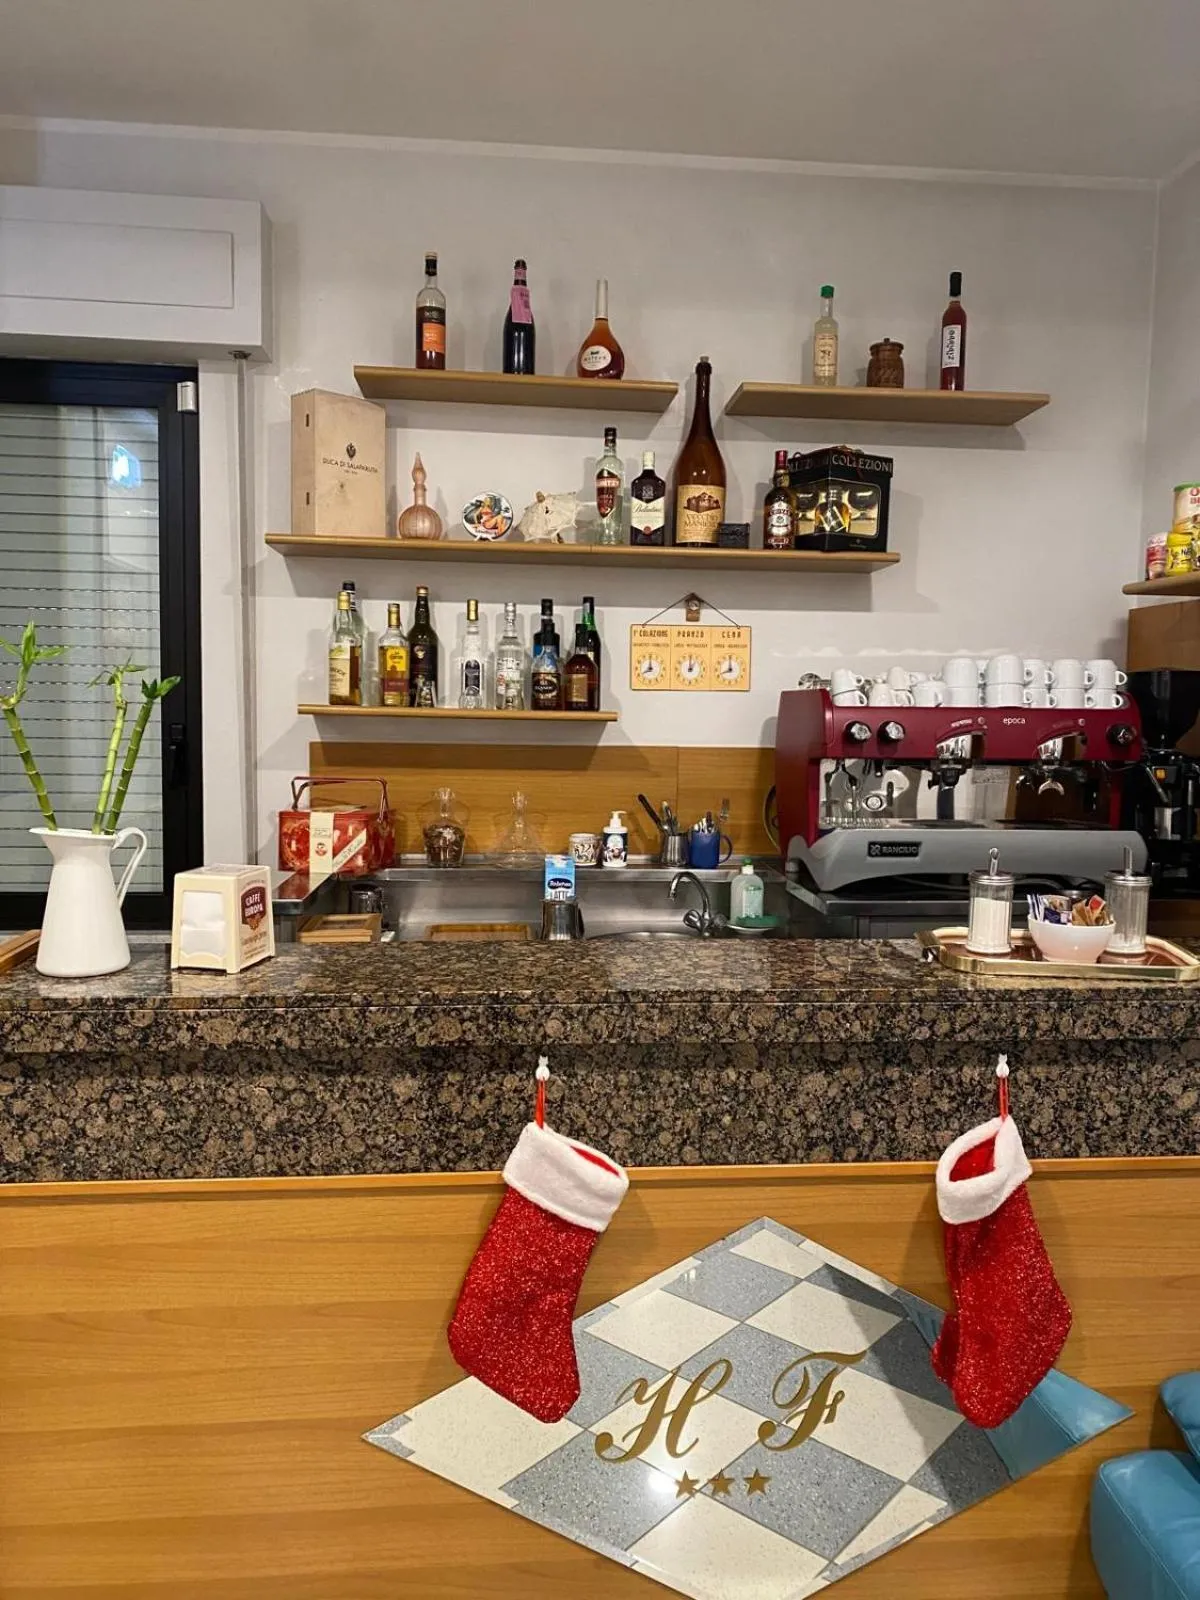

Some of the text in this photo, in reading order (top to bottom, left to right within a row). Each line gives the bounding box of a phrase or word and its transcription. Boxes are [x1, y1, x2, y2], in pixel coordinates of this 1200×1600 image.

[832, 454, 893, 473] COLLEZIONI
[1003, 717, 1026, 725] epoca
[594, 1350, 868, 1464] H F
